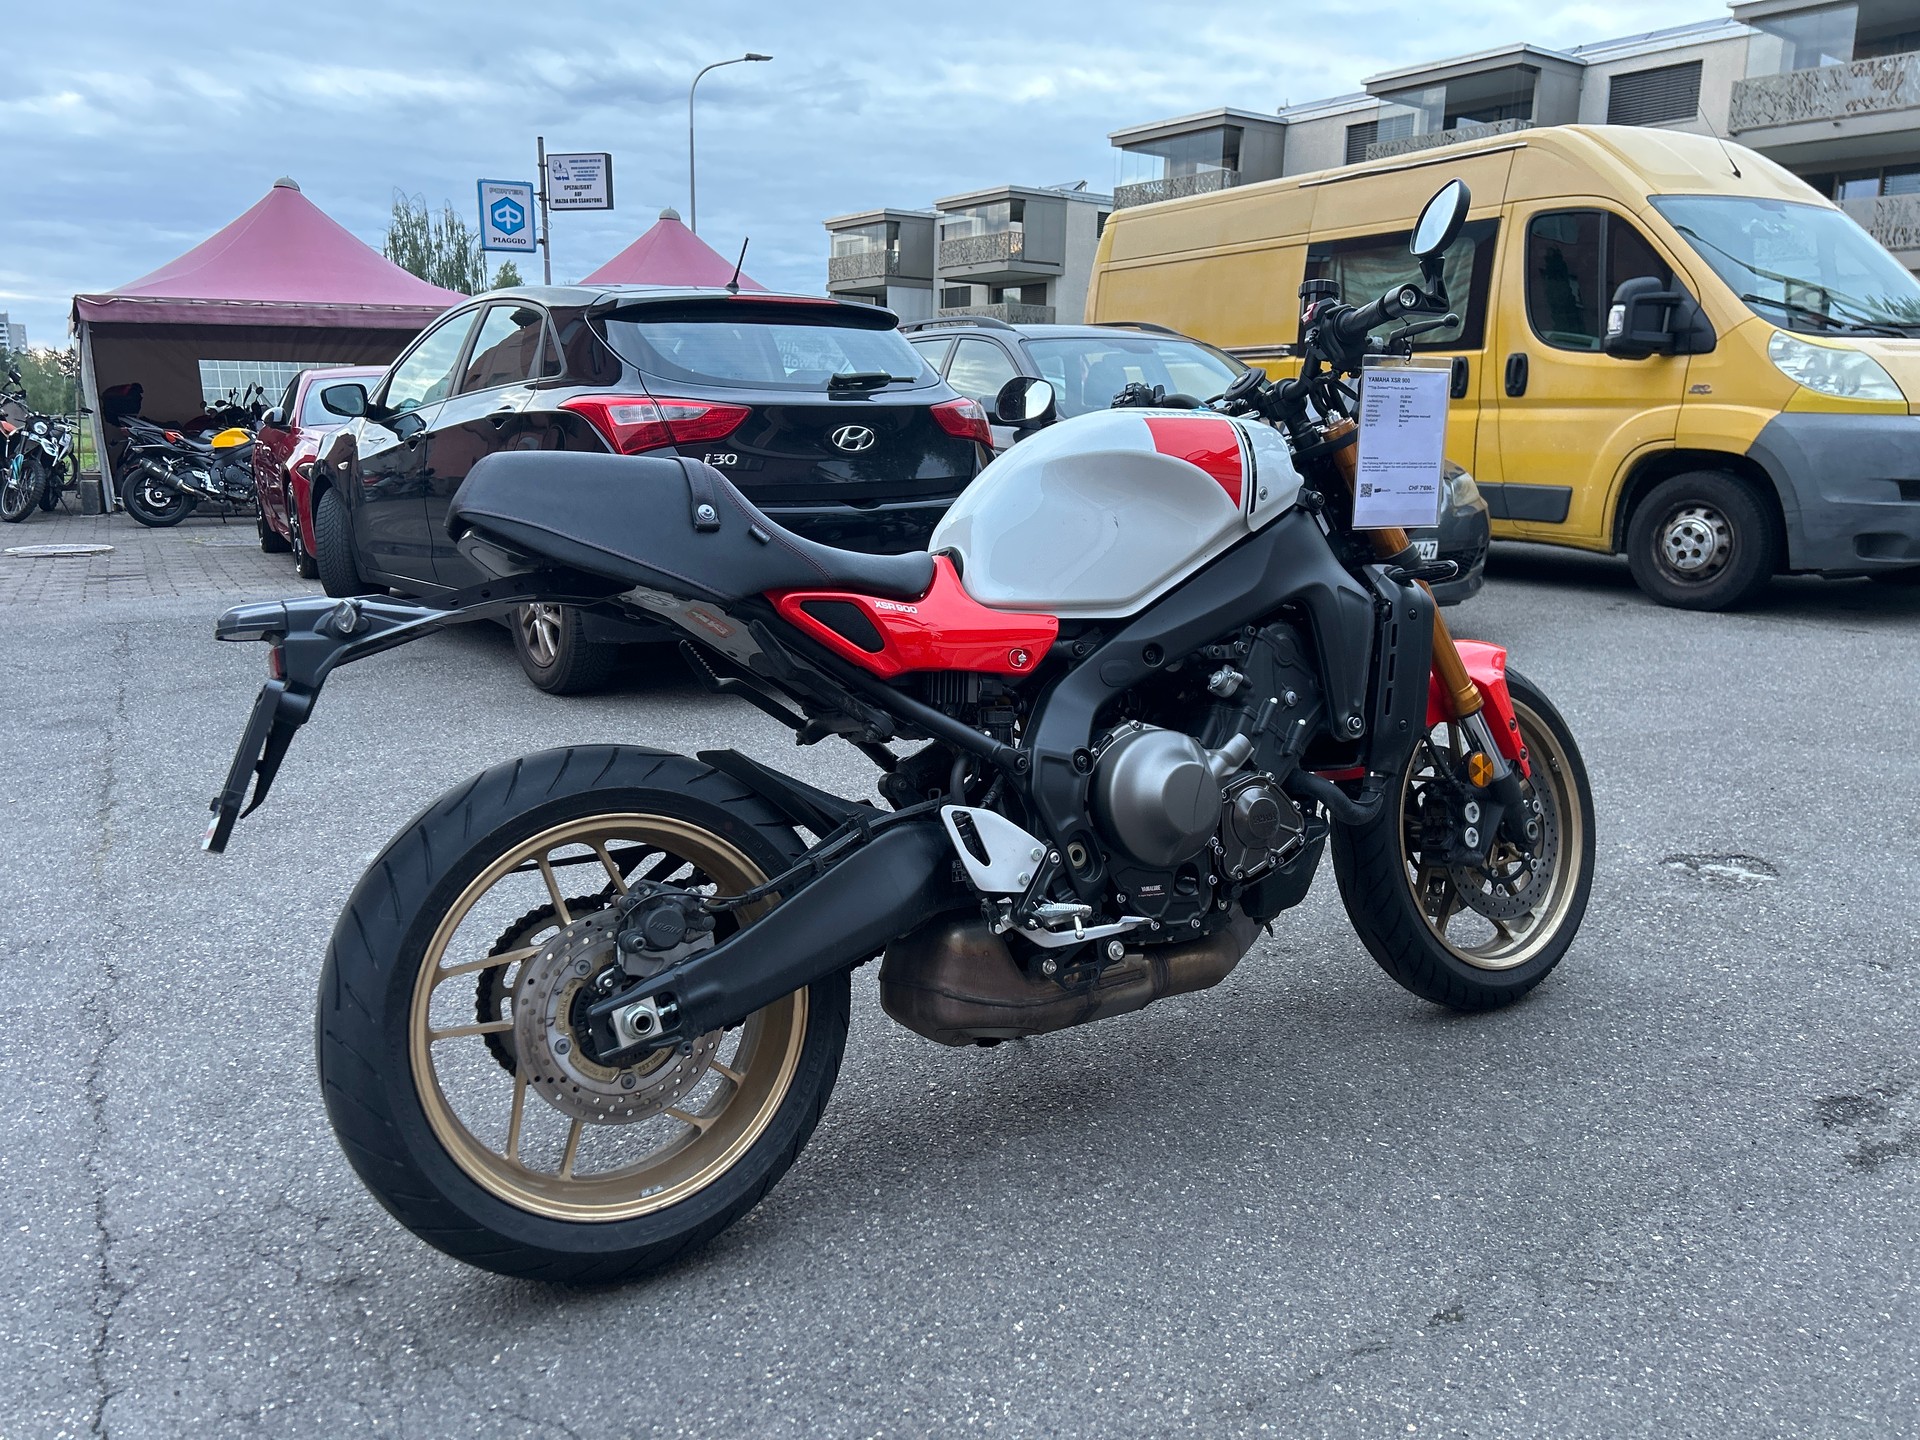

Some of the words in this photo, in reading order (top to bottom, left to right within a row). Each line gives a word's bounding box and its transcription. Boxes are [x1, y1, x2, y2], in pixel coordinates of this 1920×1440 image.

[704, 453, 738, 466] i30
[874, 600, 896, 610] XSR
[896, 604, 918, 614] 900
